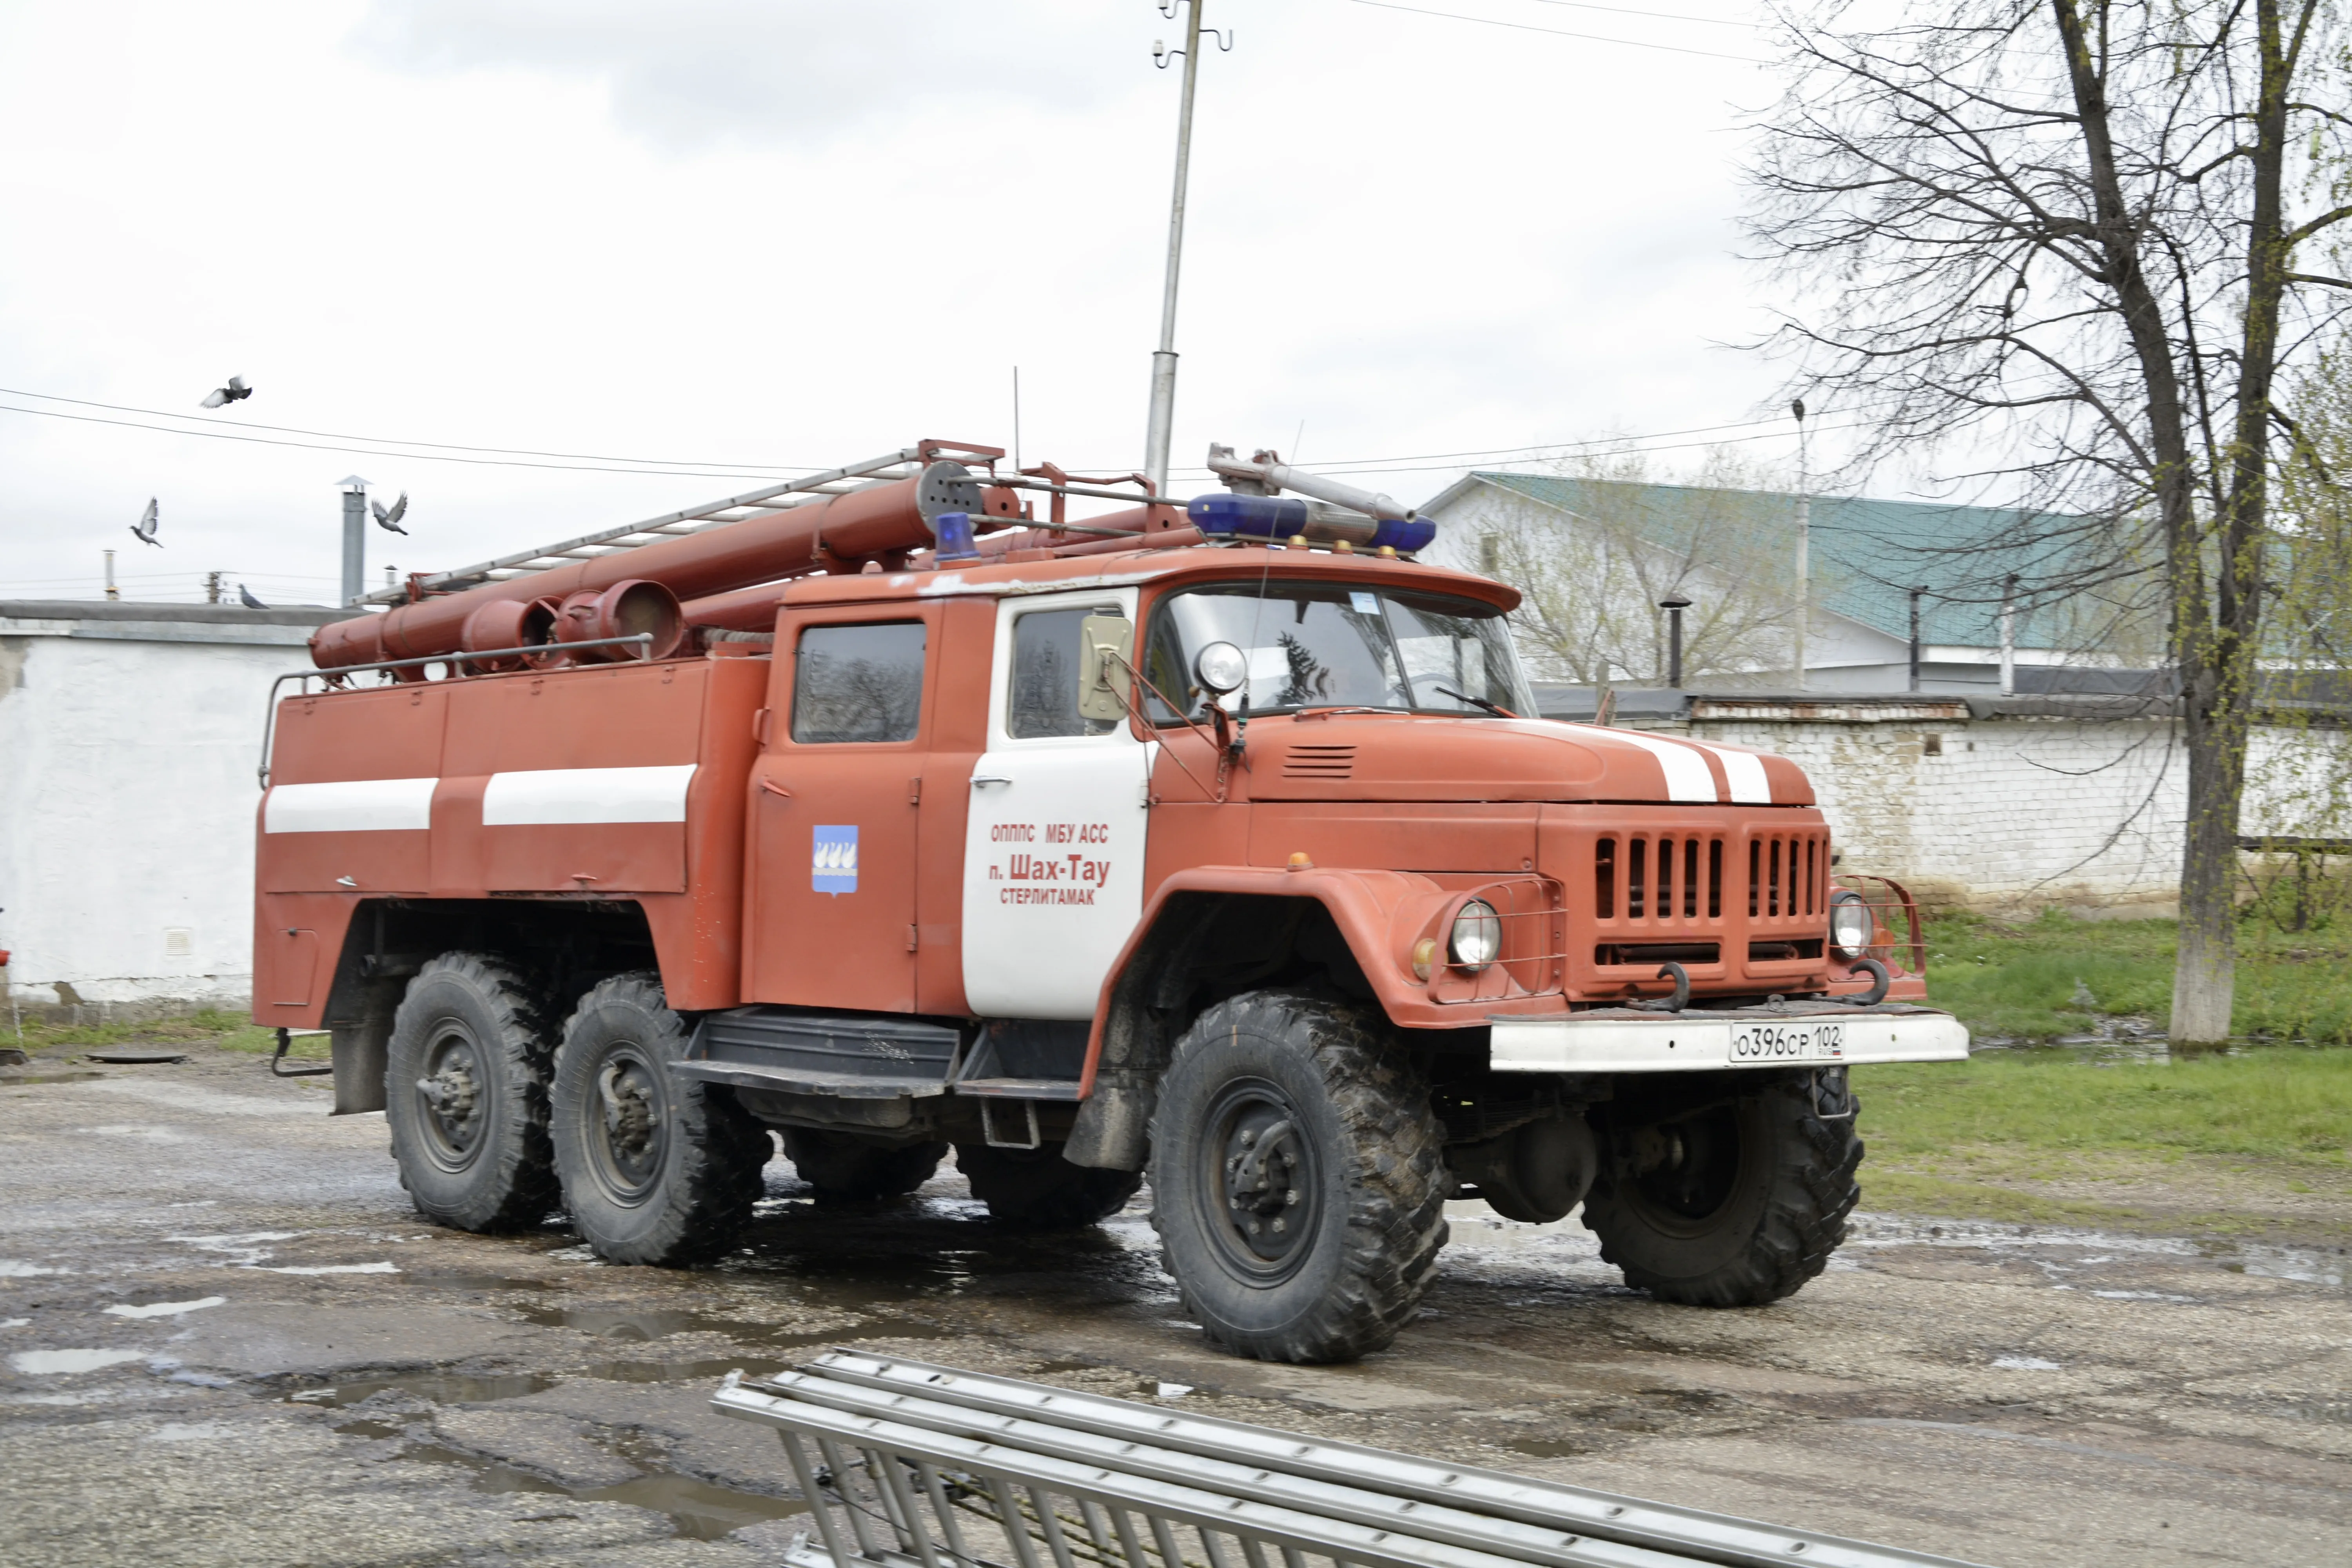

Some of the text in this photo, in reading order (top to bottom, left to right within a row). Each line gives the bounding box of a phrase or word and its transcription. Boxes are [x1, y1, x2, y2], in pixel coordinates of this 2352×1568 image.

[992, 824, 1109, 843] ОПППС МБУ АСС
[989, 854, 1111, 888] п. Шах-Тау
[1001, 888, 1095, 905] СТЕРЛИТАМАК
[1814, 1026, 1839, 1047] 102
